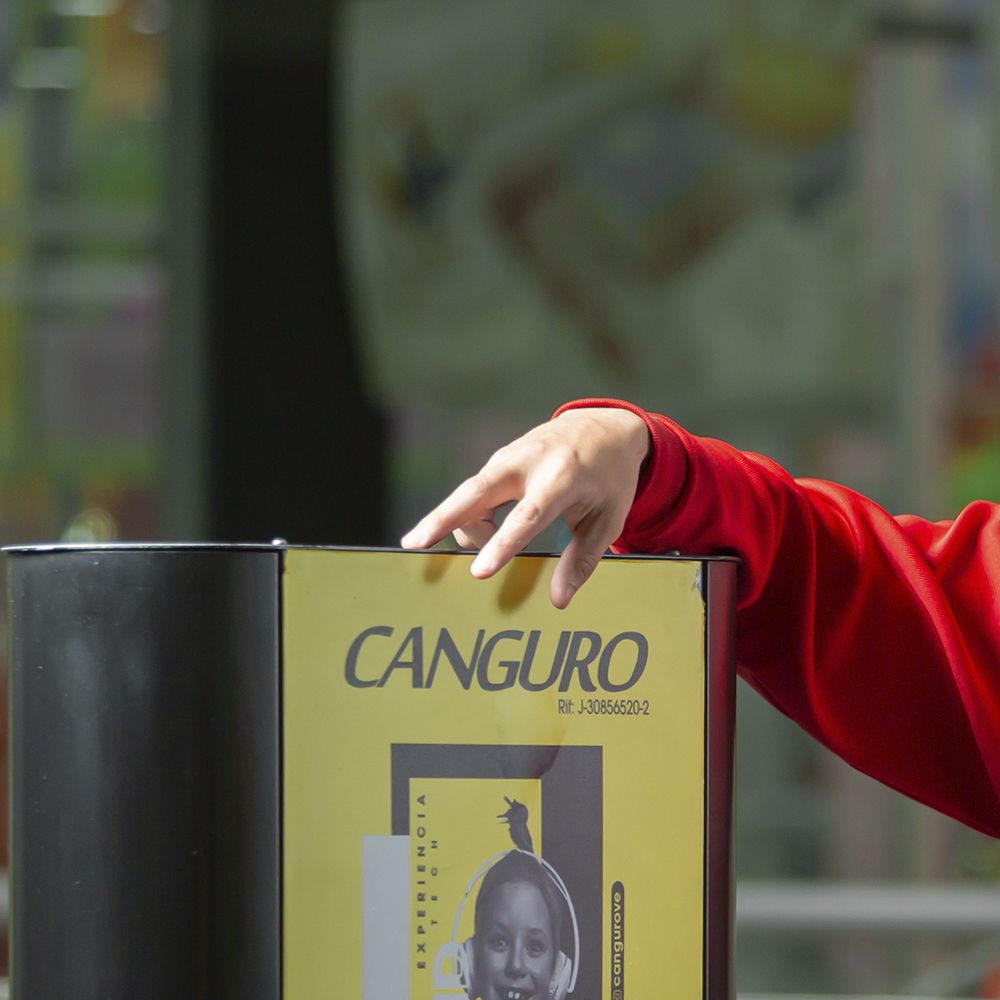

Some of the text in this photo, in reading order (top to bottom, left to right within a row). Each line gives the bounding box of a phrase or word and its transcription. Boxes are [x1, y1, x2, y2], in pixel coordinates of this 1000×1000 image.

[344, 625, 650, 692] CANGURO
[578, 699, 650, 715] J-30856520-2
[416, 794, 426, 969] EXPERIENCIA
[430, 840, 438, 925] TECH
[613, 892, 624, 987] cangurove
